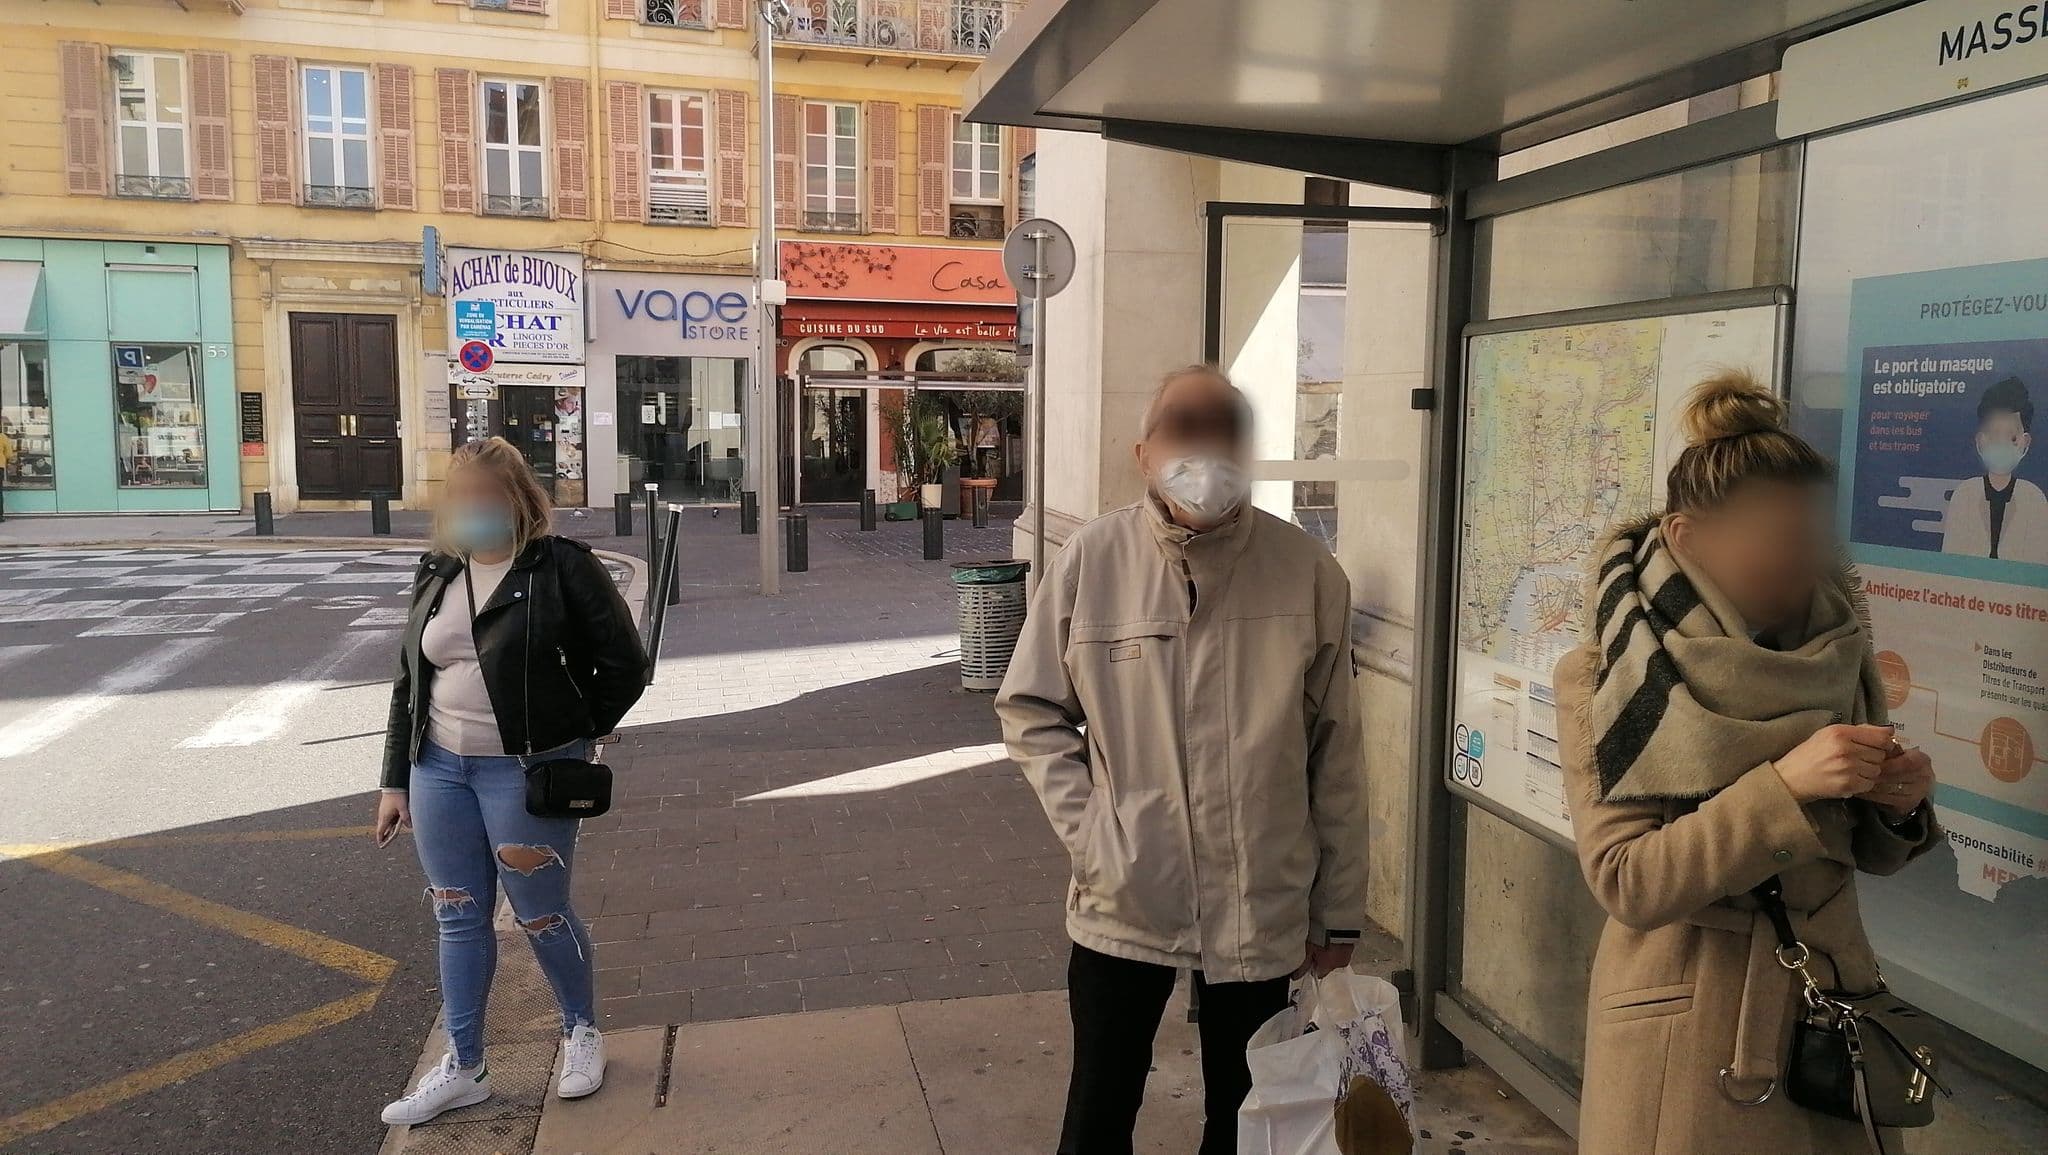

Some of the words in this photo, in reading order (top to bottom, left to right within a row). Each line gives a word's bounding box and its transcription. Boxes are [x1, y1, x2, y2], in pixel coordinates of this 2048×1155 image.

[452, 255, 502, 297] ACHAT
[504, 254, 519, 284] de
[522, 256, 577, 303] BIJOUX
[932, 261, 1006, 291] Casa
[478, 298, 554, 309] TICULIERS
[496, 313, 562, 330] HAT
[615, 289, 748, 339] vape
[688, 326, 748, 340] STORE
[800, 324, 843, 333] CUISINE
[847, 324, 860, 333] DU
[865, 324, 884, 334] SUD
[915, 324, 928, 335] La
[956, 325, 973, 335] est
[977, 325, 1000, 336] belle
[488, 333, 507, 348] R
[513, 332, 553, 341] LINGOTS
[546, 342, 569, 350] D'OR
[208, 345, 228, 358] 55
[1874, 359, 1890, 374] Le
[1892, 358, 1919, 376] port
[1920, 357, 1937, 372] du
[1940, 358, 1994, 374] masque
[1873, 380, 1893, 395] est
[1894, 378, 1966, 397] obligatoire
[1871, 411, 1890, 422] pour
[1895, 411, 1930, 423] voyager
[1870, 425, 1890, 435] dans
[1892, 426, 1905, 435] les
[1906, 425, 1923, 436] bus
[1869, 441, 1878, 450] et
[1879, 441, 1893, 450] les
[1894, 441, 1921, 451] trams
[1864, 580, 1920, 602] Anticipez
[1922, 588, 1965, 610] l'achat
[1968, 596, 1985, 612] de
[1988, 602, 2012, 617] vos
[1984, 645, 2000, 657] Dans
[2001, 648, 2013, 659] les
[1983, 659, 2027, 677] Distributeurs
[2028, 669, 2038, 679] de
[1982, 673, 2001, 686] Titres
[2013, 680, 2045, 696] Transport
[1946, 829, 2034, 868] responsabilité
